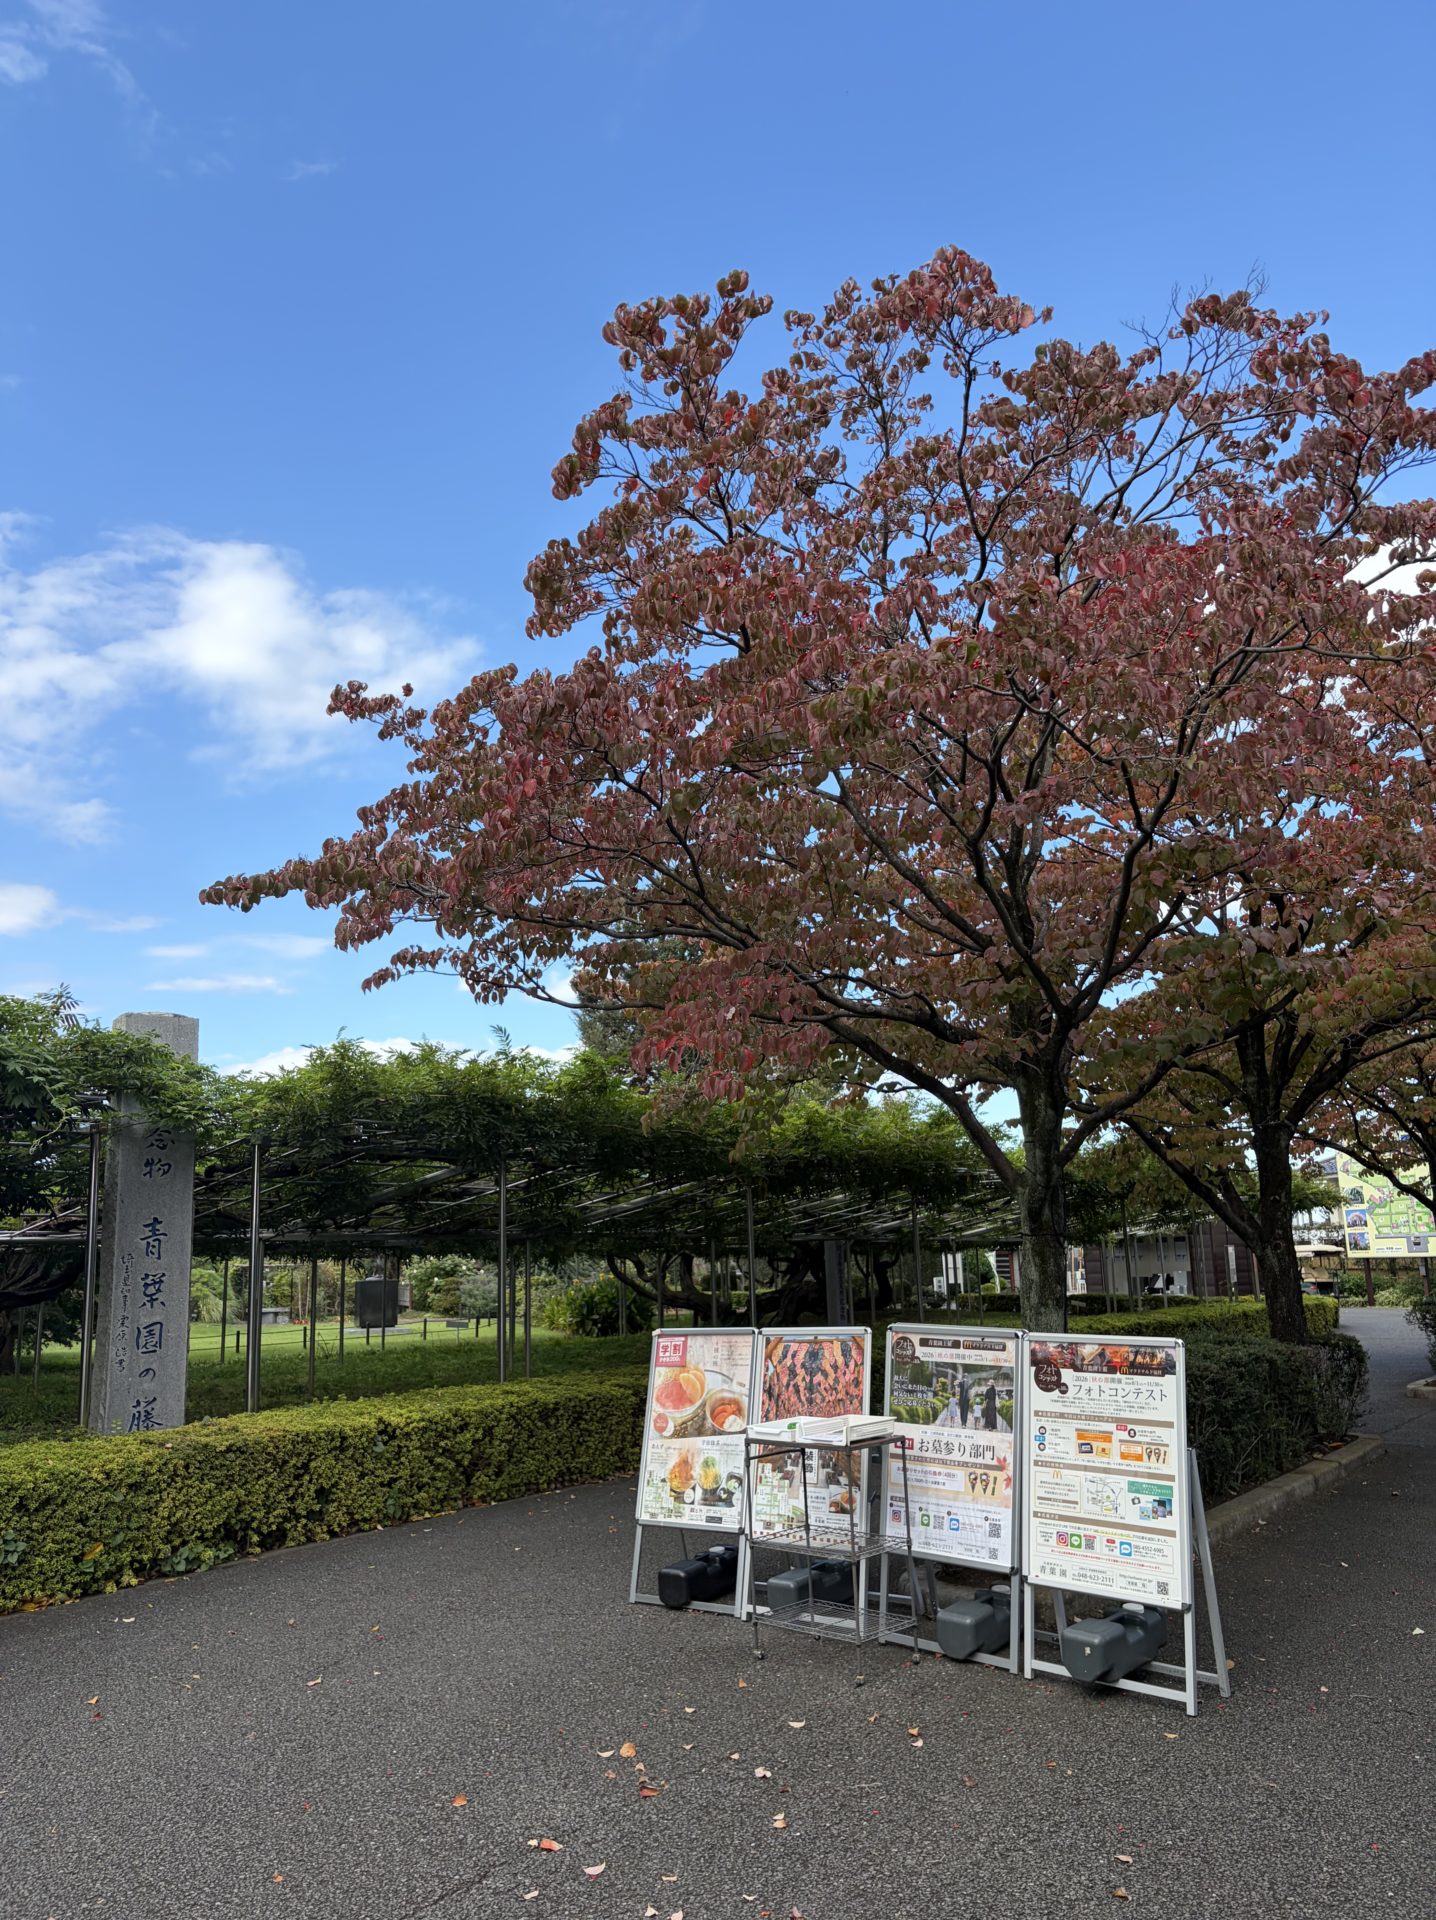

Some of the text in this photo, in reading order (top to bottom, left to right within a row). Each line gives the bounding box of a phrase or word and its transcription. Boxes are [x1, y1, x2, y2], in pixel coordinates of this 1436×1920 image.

[128, 1128, 175, 1433] 念物 青葉園の藤
[660, 1343, 681, 1355] 学割
[1038, 1364, 1058, 1374] フォト
[1074, 1375, 1088, 1383] 2026
[1072, 1383, 1168, 1403] フォトコンテスト
[918, 1438, 996, 1461] お墓参り部門
[1039, 1565, 1068, 1578] 青葉園
